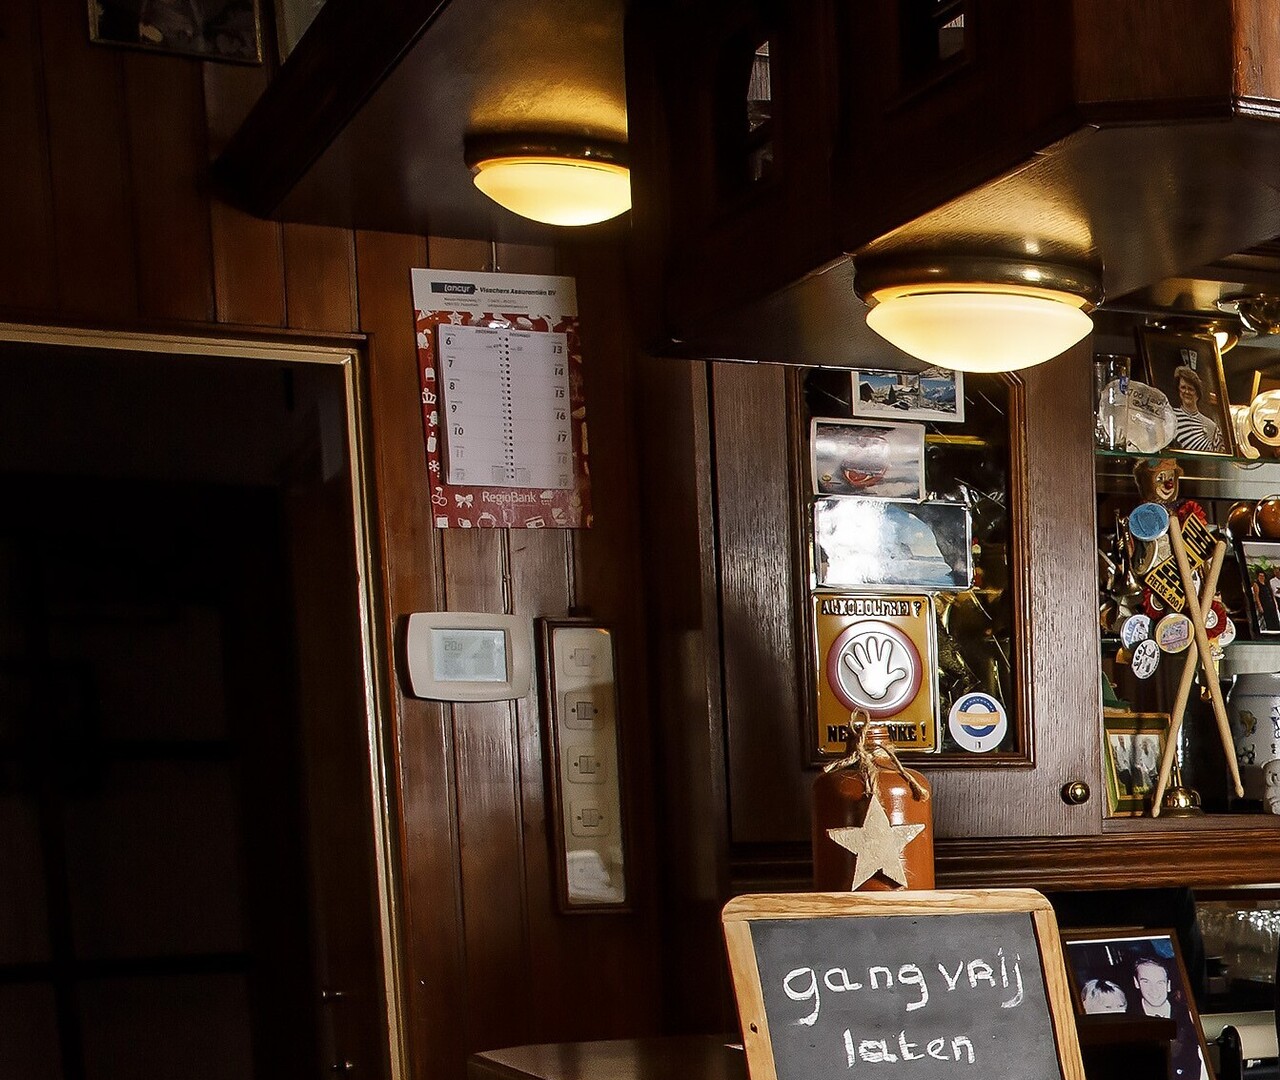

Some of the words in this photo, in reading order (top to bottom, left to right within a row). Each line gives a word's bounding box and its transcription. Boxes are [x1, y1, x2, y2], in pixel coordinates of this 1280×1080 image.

[445, 336, 452, 345] 6
[553, 345, 563, 354] 13
[448, 359, 453, 367] 7
[554, 368, 564, 376] 14
[449, 382, 455, 390] 8
[555, 389, 565, 398] 15
[451, 404, 457, 412] 9
[556, 412, 566, 420] 16
[454, 427, 464, 435] 10
[557, 434, 567, 442] 17
[482, 491, 537, 505] RegioBank
[782, 963, 930, 1027] gang
[842, 1028, 976, 1068] laten
